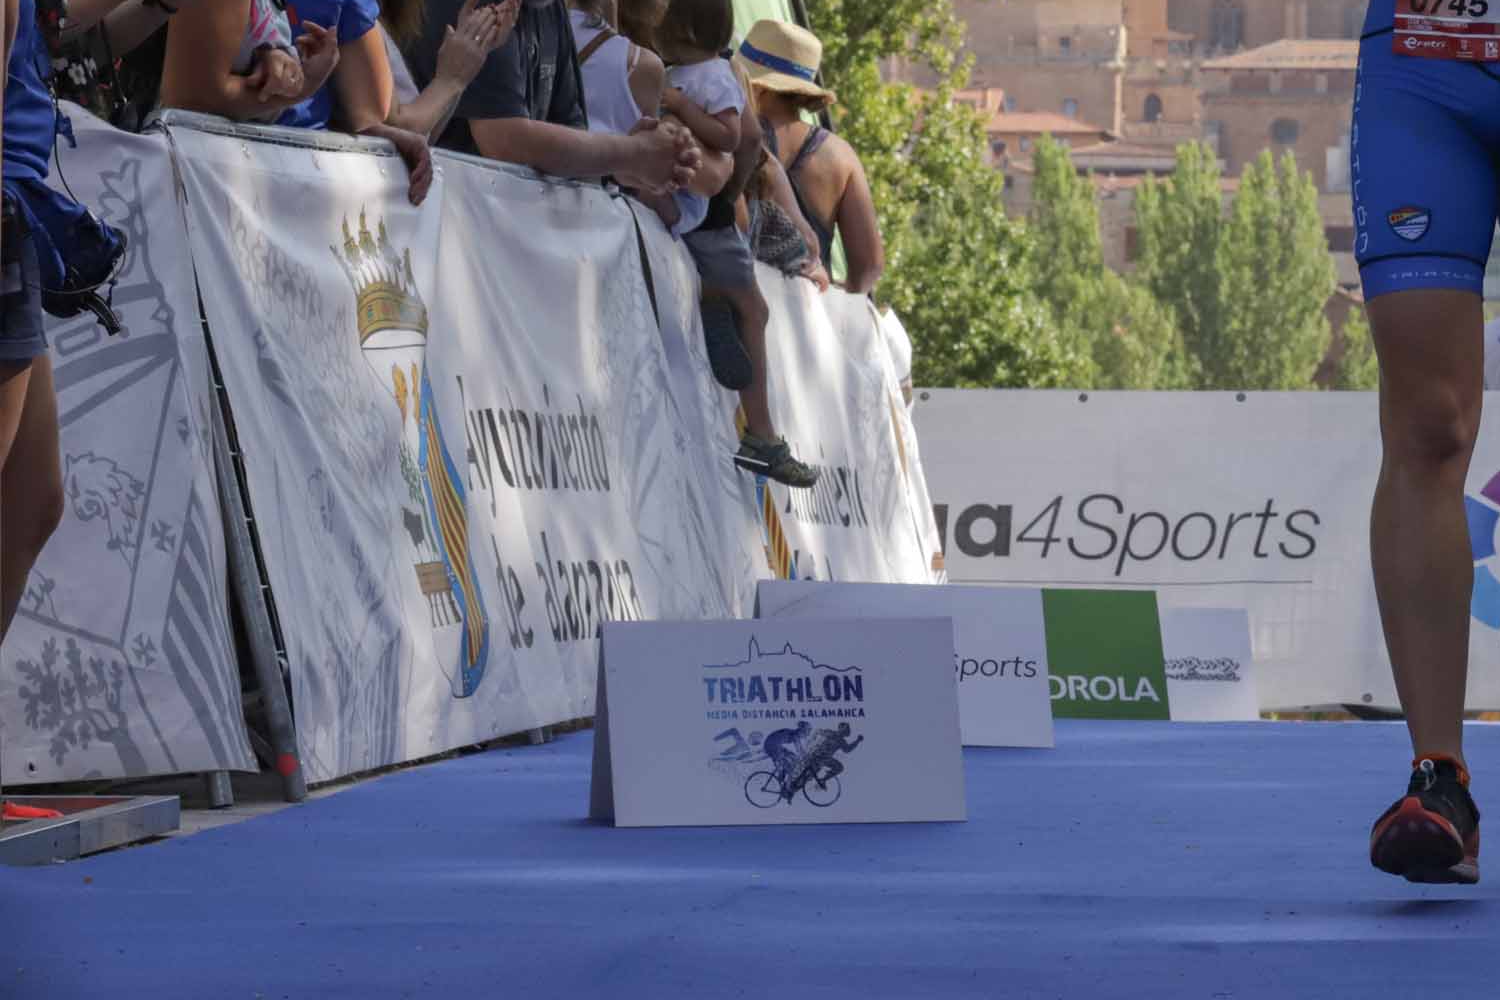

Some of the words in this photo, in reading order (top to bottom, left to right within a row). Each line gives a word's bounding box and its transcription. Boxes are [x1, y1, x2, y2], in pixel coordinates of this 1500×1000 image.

[703, 674, 865, 704] TRIATHLON
[706, 709, 738, 721] MEDIA
[742, 709, 797, 720] DISTANCIA
[801, 708, 866, 720] SALAMANCA
